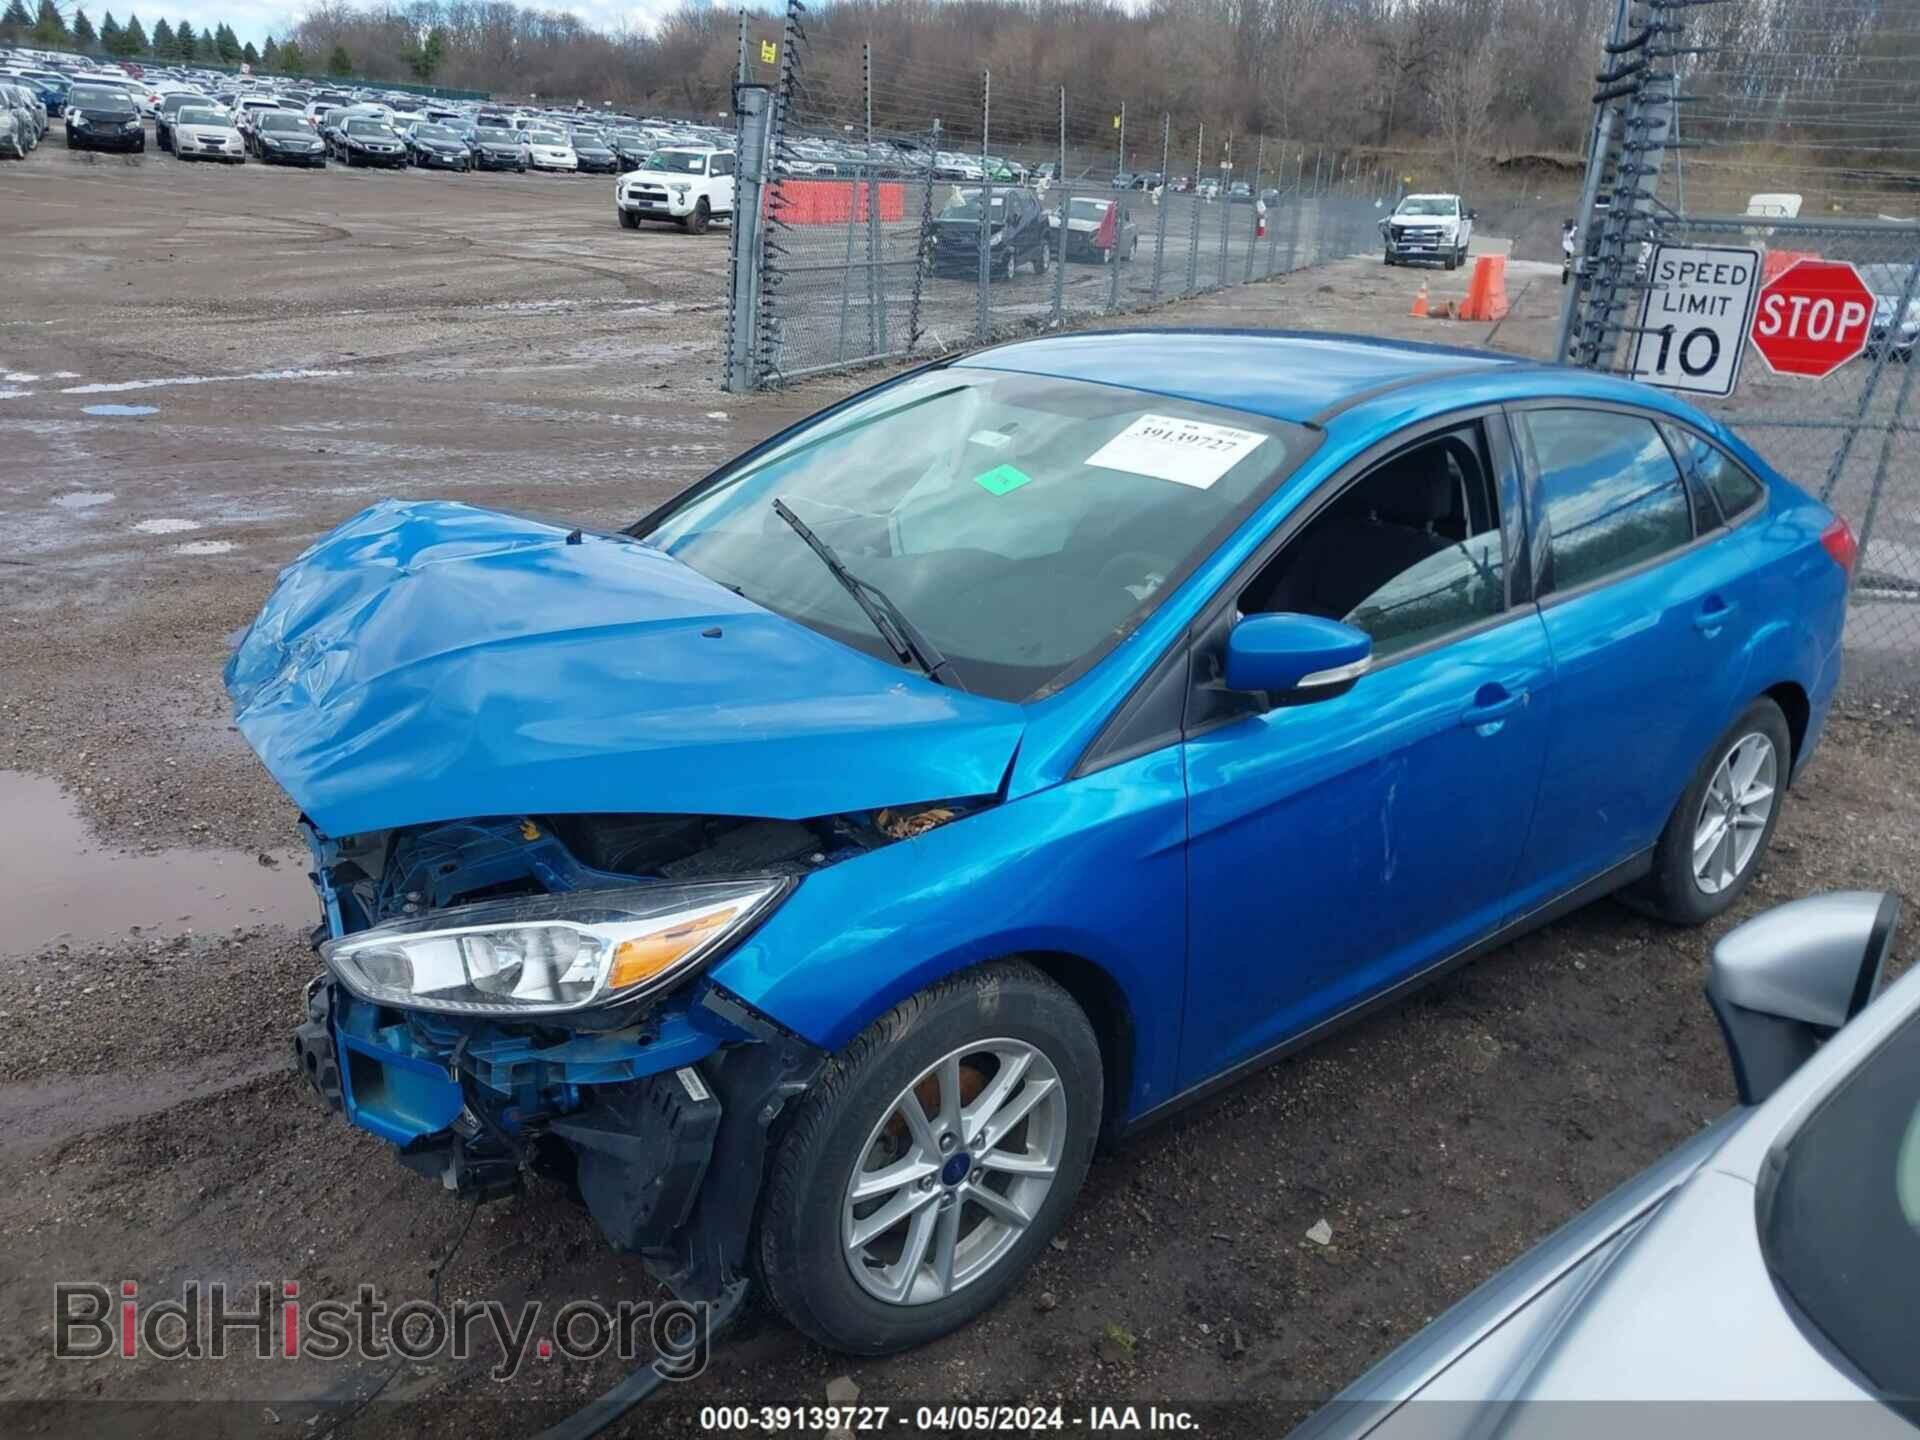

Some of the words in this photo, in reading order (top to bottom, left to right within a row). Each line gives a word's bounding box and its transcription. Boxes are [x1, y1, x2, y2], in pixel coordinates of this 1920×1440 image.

[1660, 260, 1748, 286] SPEED
[1663, 292, 1732, 317] LIMIT
[1758, 293, 1866, 343] STOP
[1655, 323, 1721, 376] 10
[1137, 425, 1238, 452] 39139727
